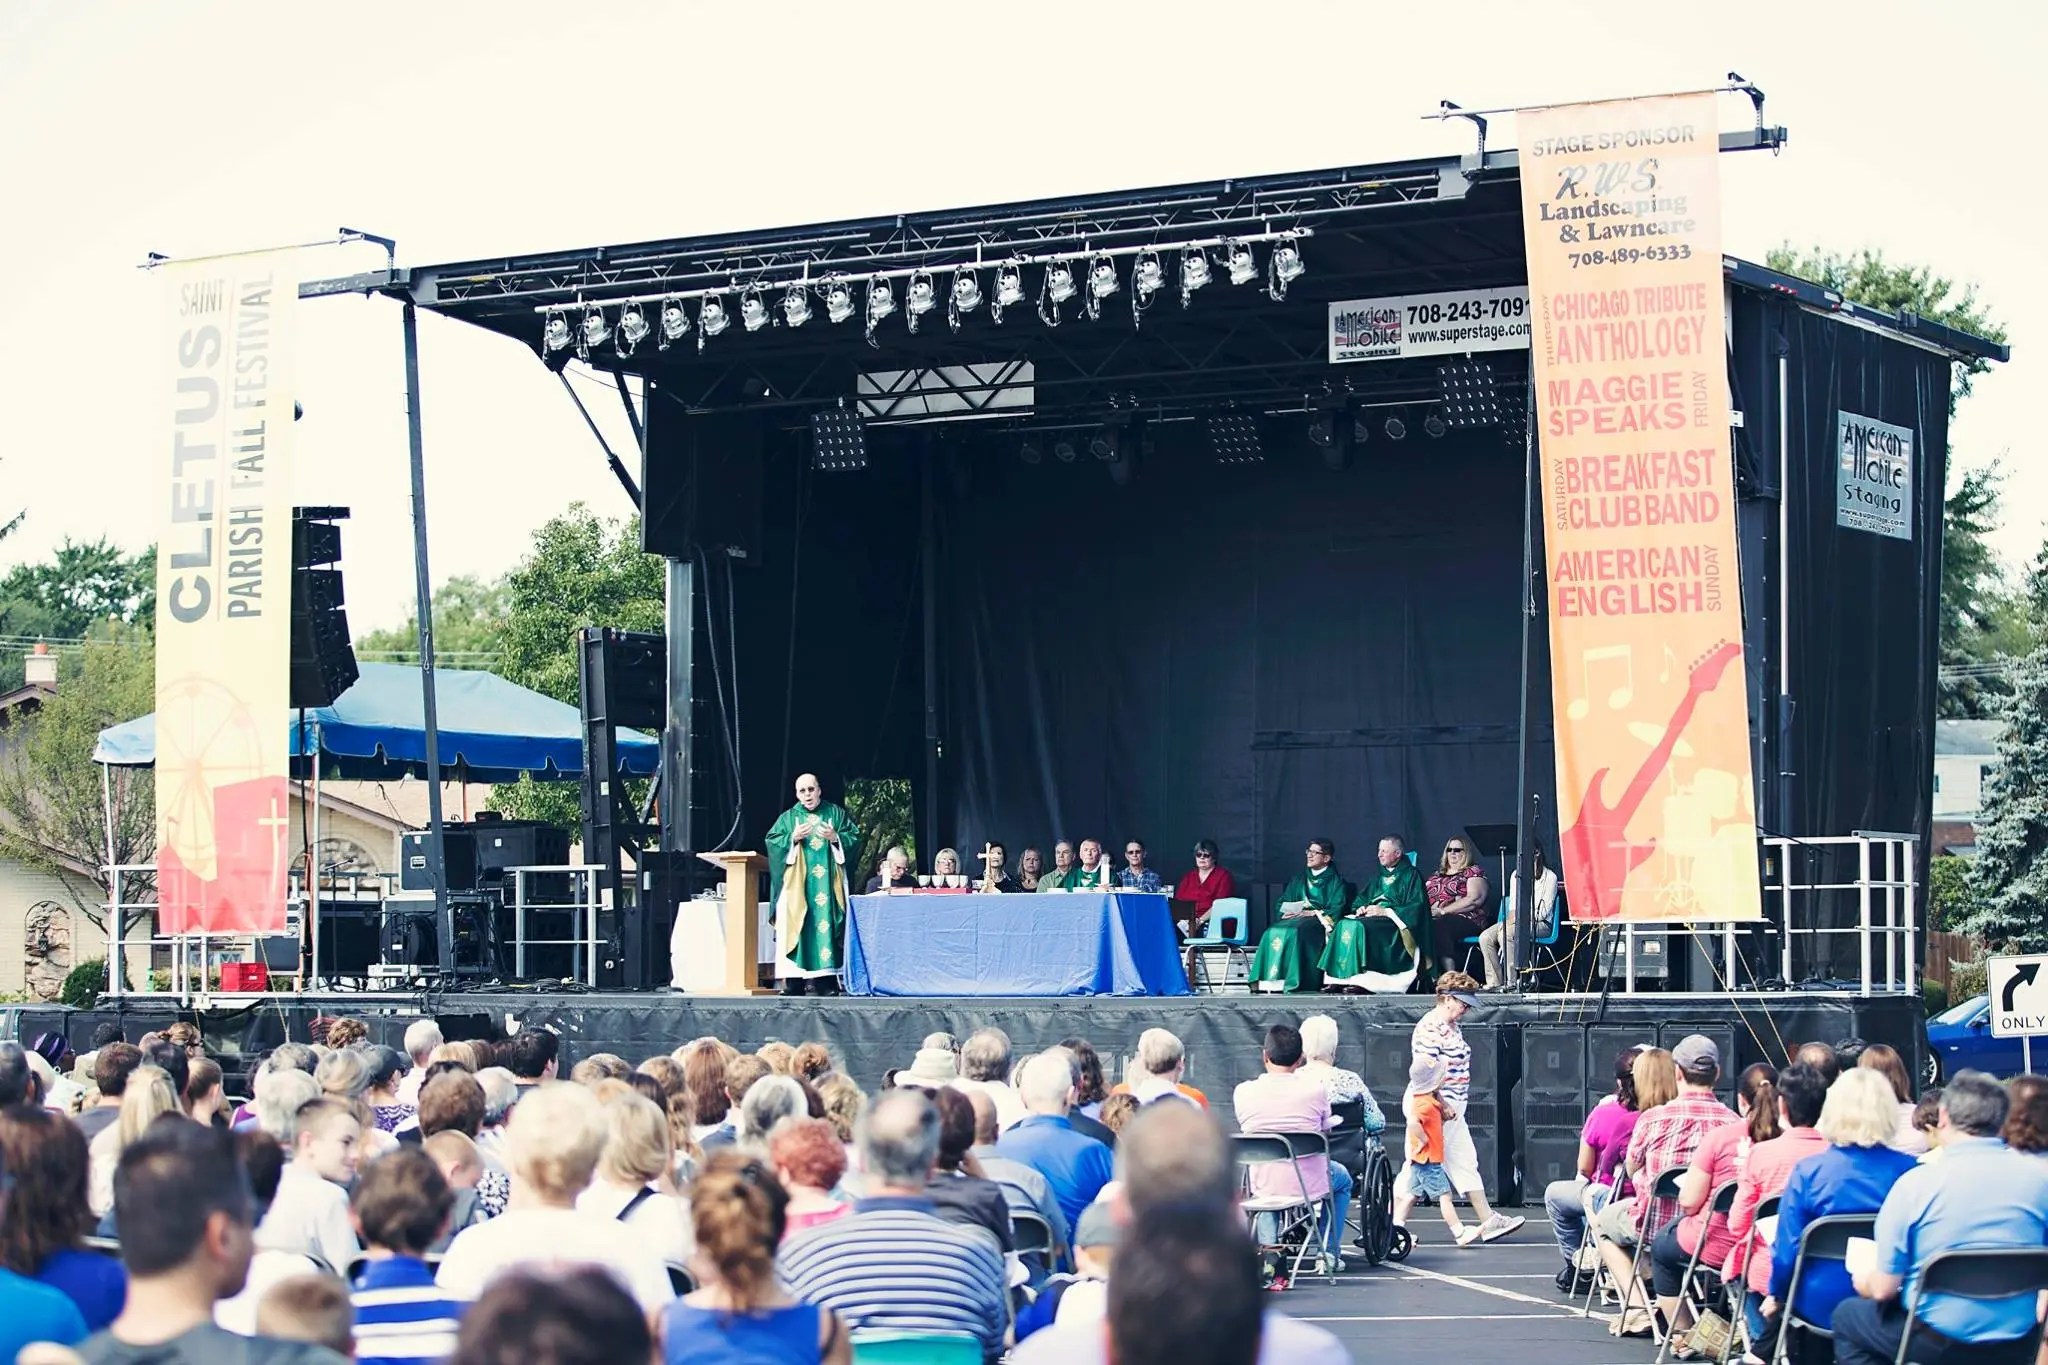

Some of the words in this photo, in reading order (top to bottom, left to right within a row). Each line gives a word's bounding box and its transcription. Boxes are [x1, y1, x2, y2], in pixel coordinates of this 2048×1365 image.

[1533, 134, 1594, 157] STAGE
[1598, 124, 1695, 150] SPONSOR
[1540, 195, 1688, 222] Landscaping
[1559, 224, 1581, 243] &
[1588, 218, 1696, 241] Lawncare
[1568, 244, 1692, 269] 708-489-6333
[180, 278, 225, 317] SAINT
[1553, 286, 1630, 322] CHICAGO
[1633, 282, 1707, 315] TRIBUTE
[233, 269, 274, 409] FESTIVAL
[1557, 315, 1706, 365] ANTHOLOGY
[1548, 371, 1684, 407] MAGGIE
[1692, 371, 1709, 428] FRIDAY
[1548, 402, 1687, 437] SPEAKS
[169, 324, 222, 624] CLETUS
[230, 420, 266, 490] FALL
[1565, 448, 1716, 494] BREAKFAST
[1553, 458, 1568, 531] SATURDAY
[227, 504, 264, 619] PARISH
[1554, 546, 1701, 583] AMERICAN
[1703, 544, 1722, 612] SUNDAY
[1557, 581, 1704, 618] ENGLISH
[2001, 1015, 2046, 1030] ONLY
